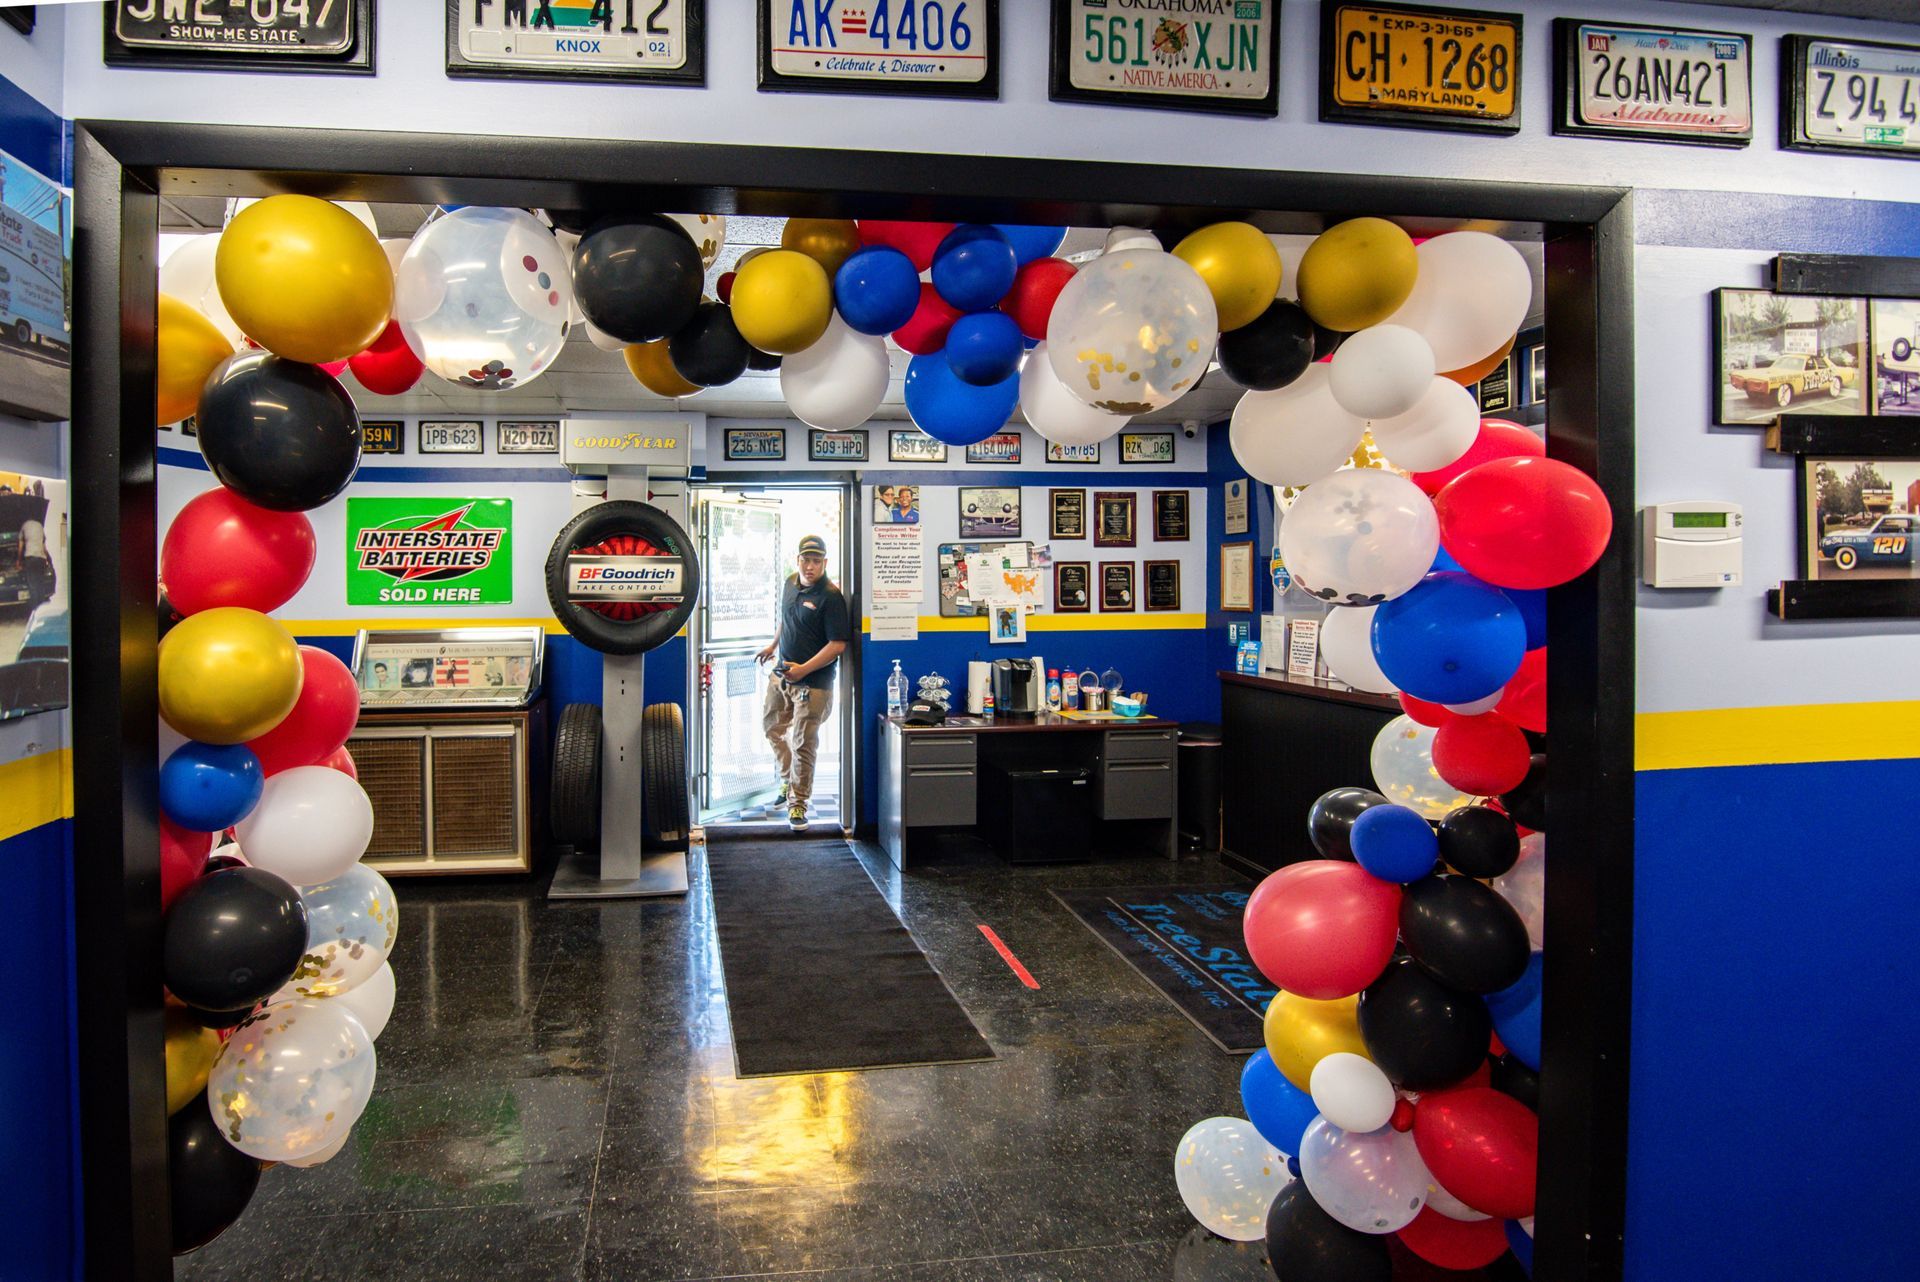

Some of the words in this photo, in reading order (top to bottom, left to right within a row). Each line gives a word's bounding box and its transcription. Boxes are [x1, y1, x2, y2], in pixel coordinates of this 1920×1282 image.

[170, 25, 246, 40] SHOW-ME
[250, 27, 299, 42] STATE
[788, 0, 837, 48] AK
[869, 0, 972, 51] 4406
[556, 39, 602, 53] KNOX
[648, 42, 665, 53] 02
[1085, 14, 1149, 66] 561
[1193, 21, 1259, 72] XJN
[1591, 38, 1607, 50] JAN
[826, 57, 875, 72] Celebrate
[878, 61, 886, 74] &
[891, 60, 936, 74] Discover
[1423, 37, 1509, 94] 1268
[1815, 48, 1860, 68] Illinois
[1123, 70, 1165, 87] NATIVE
[1167, 72, 1218, 90] AMERICA
[1593, 54, 1728, 108] 26AN421
[1383, 87, 1475, 106] MARYLAND
[1600, 104, 1728, 125] Alabama
[453, 429, 476, 445] 623
[574, 434, 676, 450] GOODYEAR
[361, 531, 497, 547] INTERSTATE
[1873, 537, 1907, 555] 120
[365, 551, 488, 567] BATTERIES
[579, 567, 675, 579] BFGoodrich
[379, 588, 427, 602] SOLD
[433, 588, 481, 601] HERE
